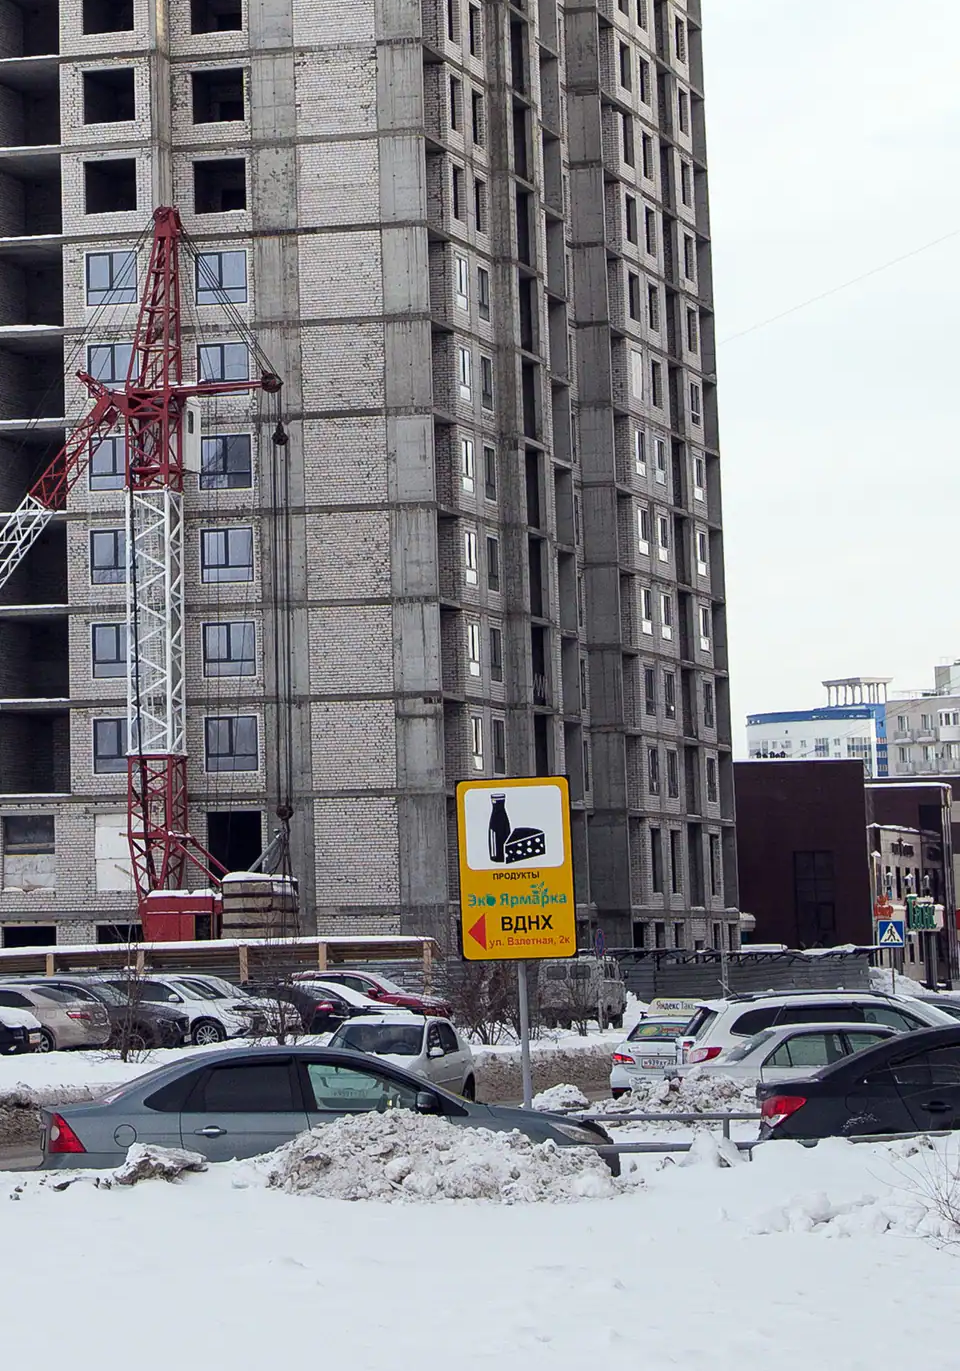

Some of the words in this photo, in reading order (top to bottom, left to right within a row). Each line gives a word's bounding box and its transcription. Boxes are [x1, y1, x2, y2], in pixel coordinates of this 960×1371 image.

[493, 871, 540, 881] ПРОДУКТЫ
[468, 893, 496, 907] Эко
[500, 892, 567, 909] Ярмарка
[501, 915, 553, 934] ВДНХ
[489, 939, 504, 949] ул.
[559, 935, 571, 944] 2к
[656, 1000, 679, 1011] Яндекс
